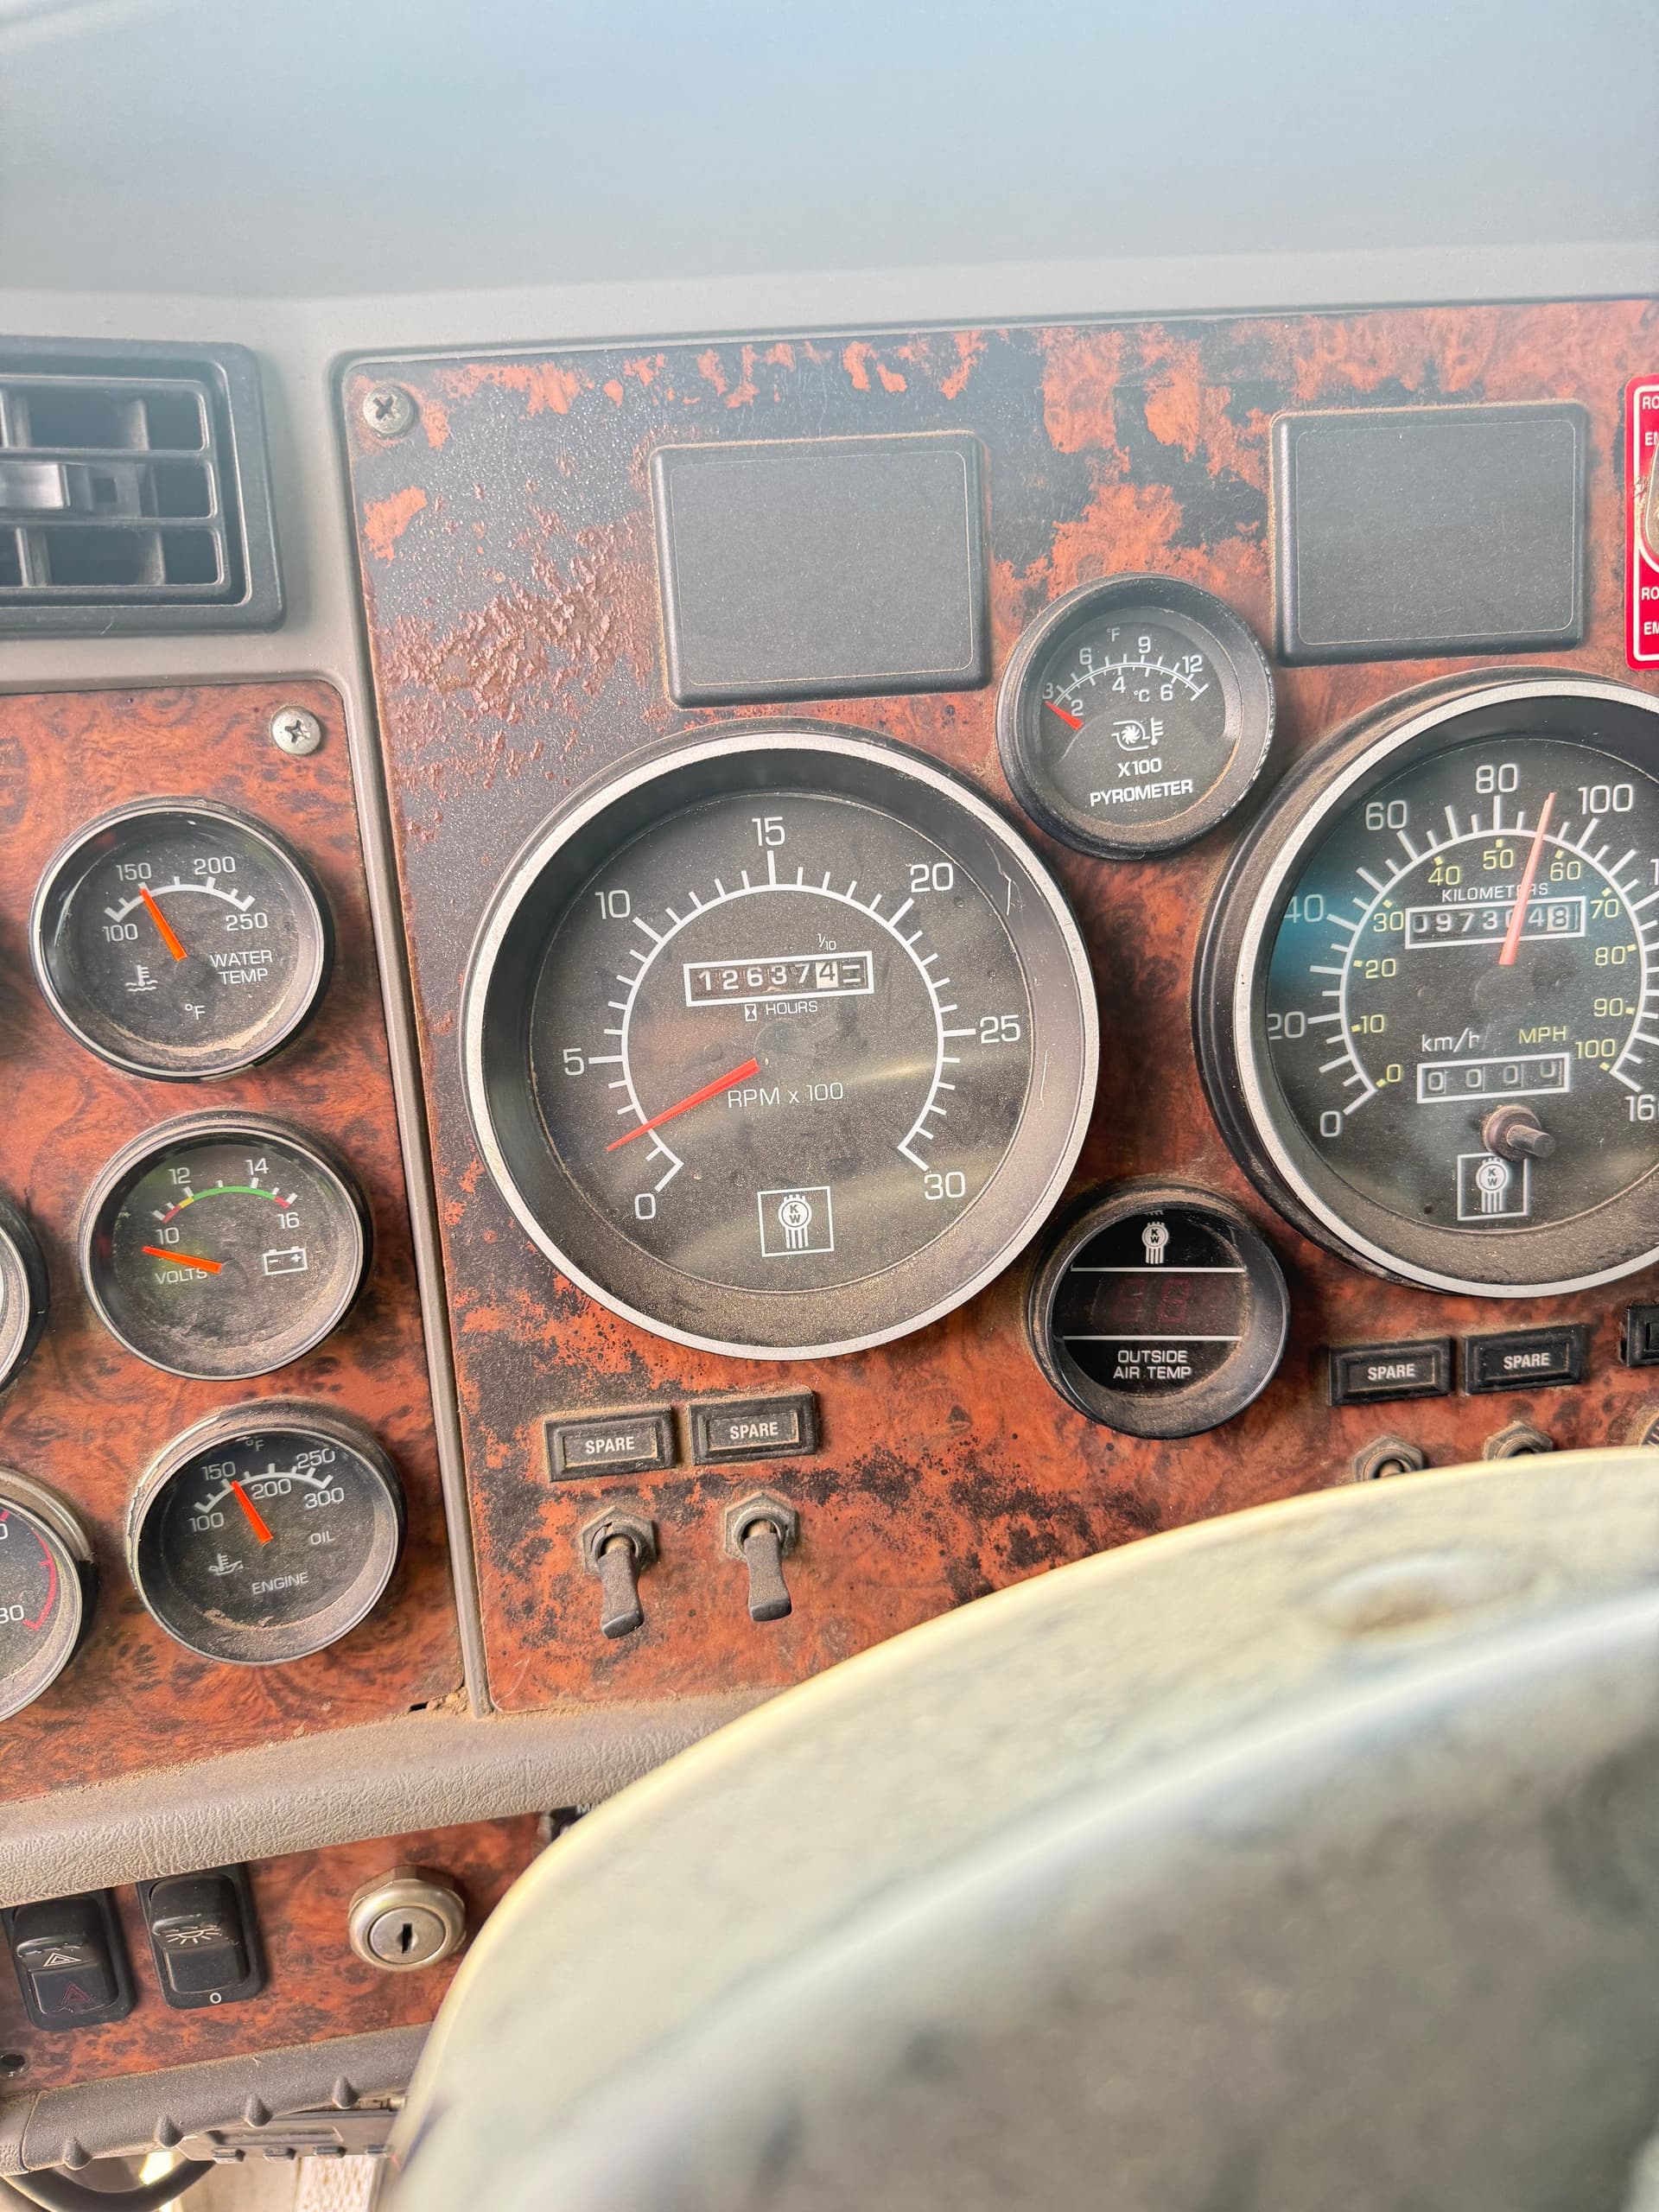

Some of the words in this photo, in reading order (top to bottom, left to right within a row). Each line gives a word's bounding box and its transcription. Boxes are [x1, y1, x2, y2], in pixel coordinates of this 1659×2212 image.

[1137, 636, 1152, 653] 9
[1079, 647, 1092, 665] 6
[1182, 655, 1203, 673] 12
[1042, 683, 1054, 700] 3
[1112, 677, 1126, 694] 4
[1160, 684, 1173, 702] 6
[1071, 699, 1084, 717] 2
[1117, 757, 1162, 779] X100
[1475, 763, 1519, 794] 80
[1090, 779, 1193, 807] PYROMETER
[1578, 783, 1634, 815] 100
[1365, 799, 1408, 831] 60
[752, 816, 785, 846] 15
[194, 855, 236, 875] 200
[1482, 848, 1515, 870] 50
[116, 861, 152, 881] 150
[909, 862, 954, 893] 20
[1427, 865, 1461, 887] 40
[1549, 861, 1582, 882] 60
[594, 889, 632, 920] 10
[1284, 893, 1325, 924] 40
[1591, 898, 1620, 920] 70
[225, 912, 268, 931] 250
[1372, 910, 1405, 933] 30
[103, 924, 139, 943] 100
[210, 950, 273, 968] WATER
[1594, 944, 1627, 966] 80
[218, 967, 269, 985] TEMP
[1365, 957, 1396, 979] 20
[766, 1001, 818, 1016] HOURS
[1593, 997, 1624, 1018] 90
[979, 1014, 1021, 1044] 25
[1267, 1011, 1306, 1040] 20
[1361, 1014, 1385, 1035] 10
[1421, 1027, 1480, 1052] km/h
[1518, 1026, 1567, 1045] MPH
[1575, 1039, 1616, 1059] 100
[563, 1047, 585, 1076] 5
[1386, 1064, 1402, 1084] 0
[728, 1087, 780, 1108] RPM
[805, 1082, 843, 1103] 100
[1624, 1094, 1659, 1122] 16
[1319, 1110, 1344, 1138] 0
[168, 1166, 191, 1185] 12
[245, 1157, 270, 1176] 14
[923, 1170, 966, 1200] 30
[634, 1192, 657, 1220] 0
[277, 1211, 300, 1230] 16
[156, 1227, 180, 1245] 10
[155, 1268, 208, 1285] VOLTS
[1117, 1350, 1189, 1364] OUTSIDE
[1503, 1352, 1550, 1371] SPARE
[1113, 1366, 1140, 1380] AIR
[1147, 1365, 1192, 1379] TEMP
[1367, 1363, 1416, 1382] SPARE
[729, 1421, 779, 1440] SPARE
[585, 1436, 635, 1454] SPARE
[296, 1447, 336, 1470] 250
[201, 1460, 236, 1481] 150
[251, 1478, 292, 1500] 200
[304, 1486, 345, 1510] 300
[188, 1511, 225, 1533] 100
[309, 1532, 335, 1546] OIL
[251, 1572, 309, 1595] ENGINE
